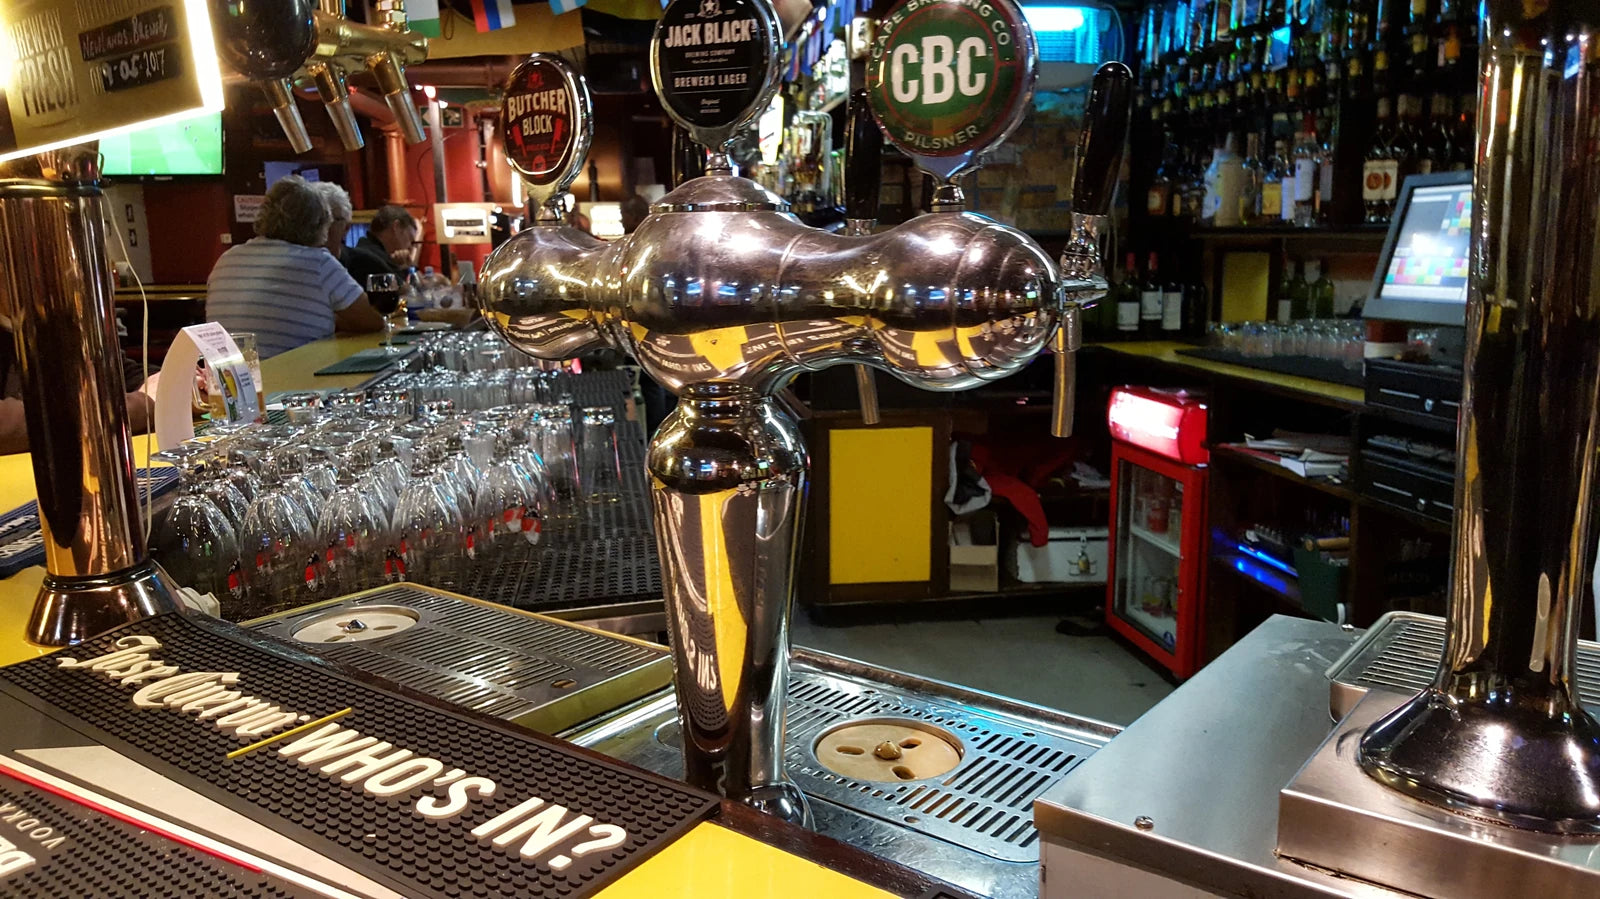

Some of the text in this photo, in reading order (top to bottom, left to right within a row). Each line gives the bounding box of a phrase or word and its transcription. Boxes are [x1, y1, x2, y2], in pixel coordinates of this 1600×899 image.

[665, 24, 701, 48] JACK
[872, 11, 904, 58] CAPE
[674, 73, 747, 88] BREWERS LAGER
[891, 35, 986, 105] CBC
[508, 88, 566, 123] BUTCHER
[523, 115, 553, 136] BLOCK
[904, 124, 980, 149] PILSNER
[278, 722, 497, 820] WHO'S
[471, 796, 627, 870] IN?
[0, 802, 66, 850] VODKA
